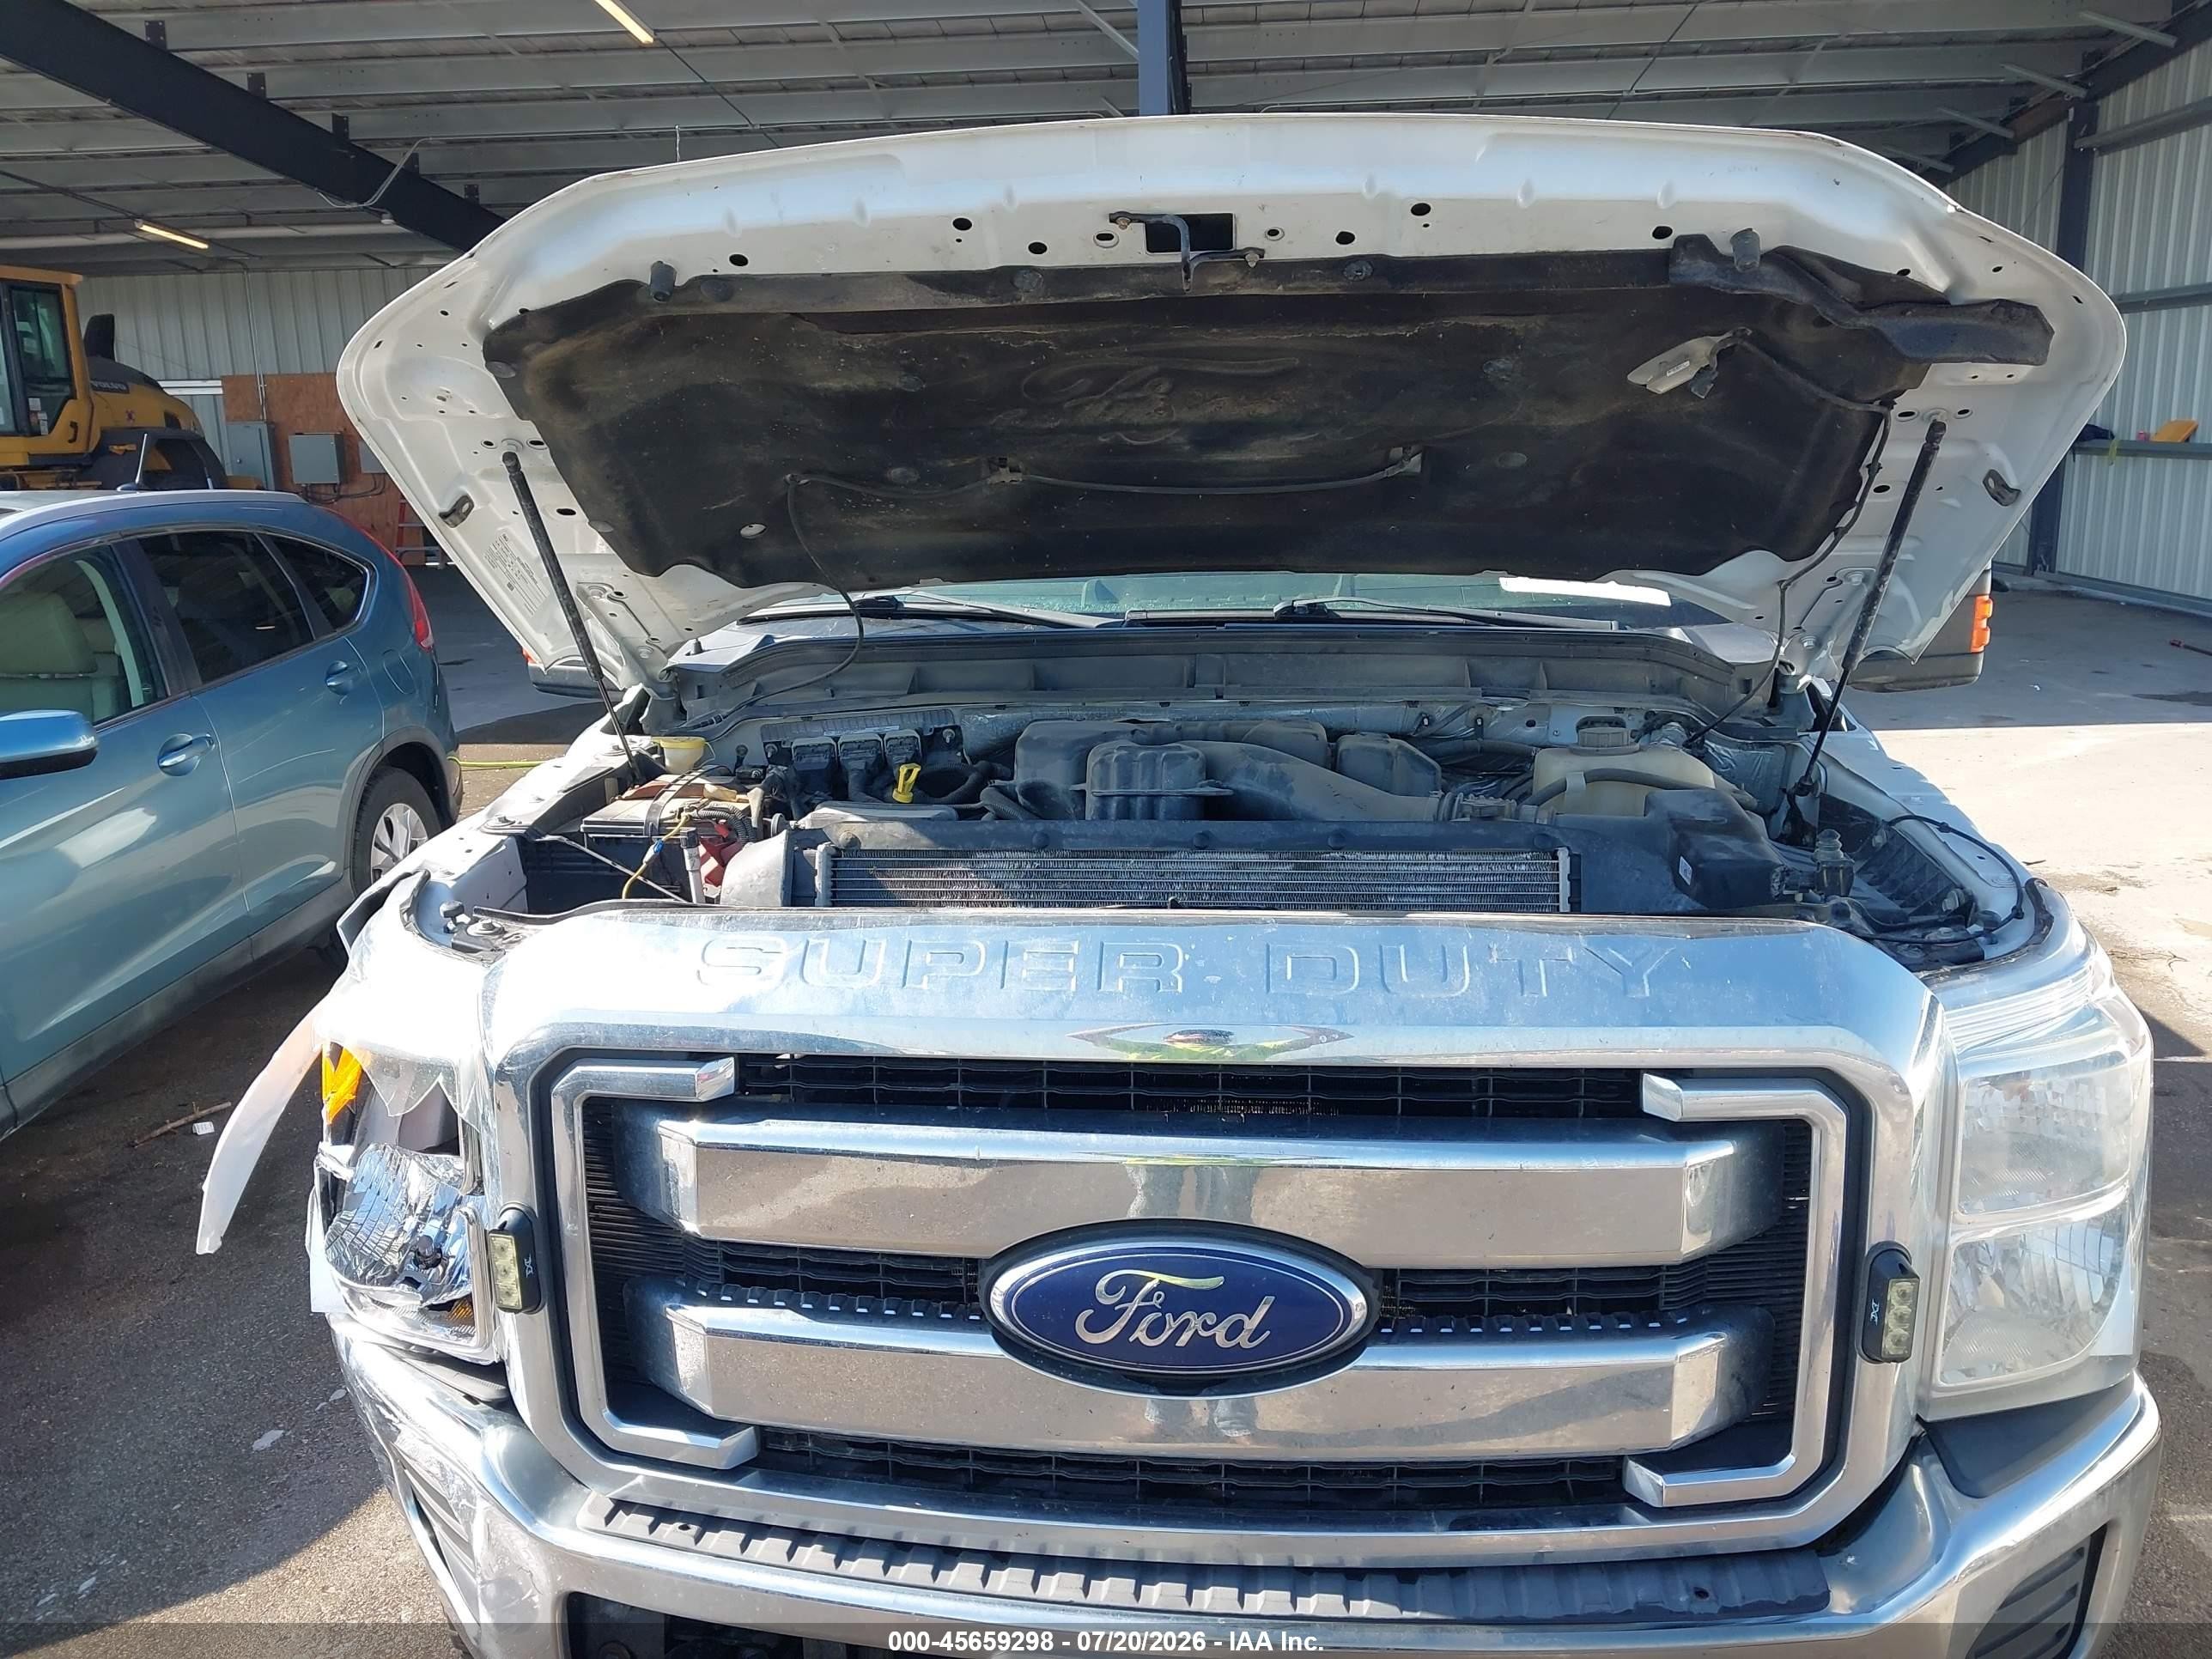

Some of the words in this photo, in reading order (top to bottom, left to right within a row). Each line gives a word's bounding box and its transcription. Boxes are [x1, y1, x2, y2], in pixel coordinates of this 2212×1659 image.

[697, 939, 1184, 994] SUPER
[1265, 944, 1676, 998] DUTY
[1075, 1269, 1275, 1349] Ford
